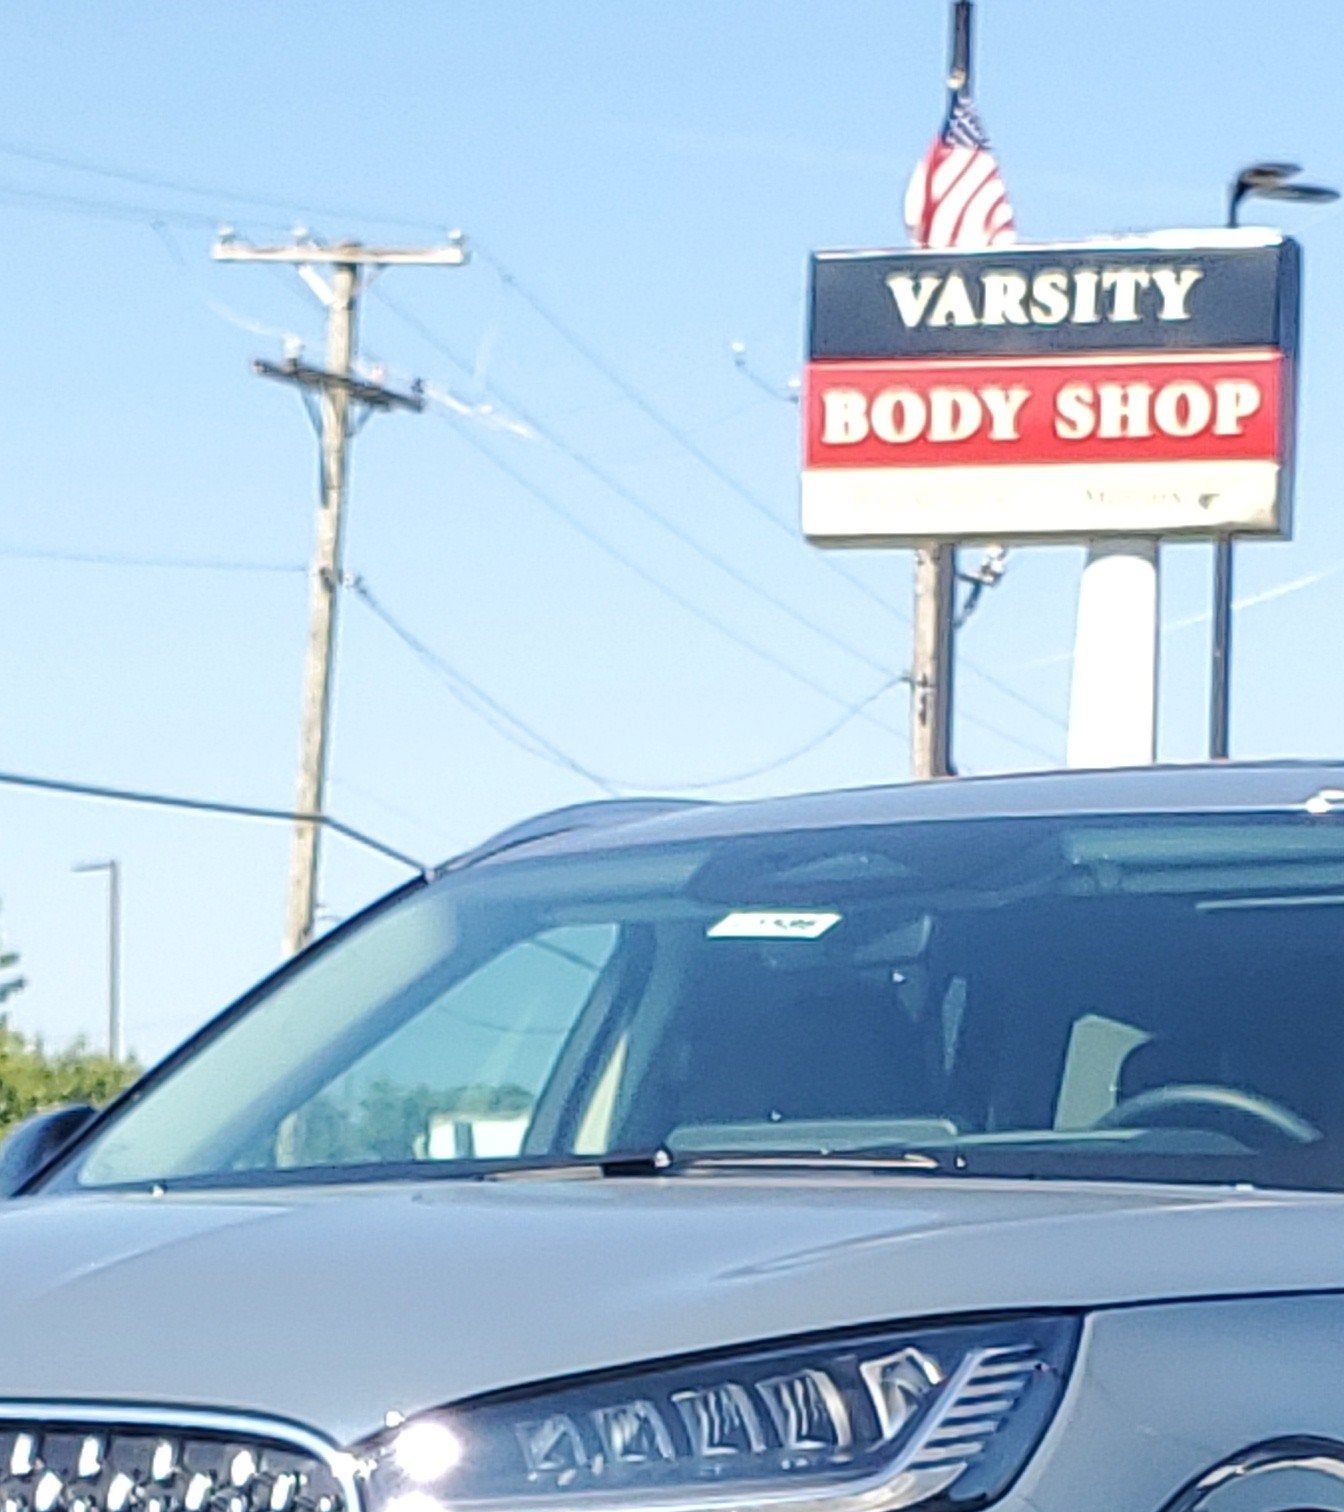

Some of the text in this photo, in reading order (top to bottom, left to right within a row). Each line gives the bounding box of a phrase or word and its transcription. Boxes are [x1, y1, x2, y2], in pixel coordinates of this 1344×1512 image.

[887, 268, 1202, 327] VARSITY
[822, 380, 1260, 444] BODY SHOP
